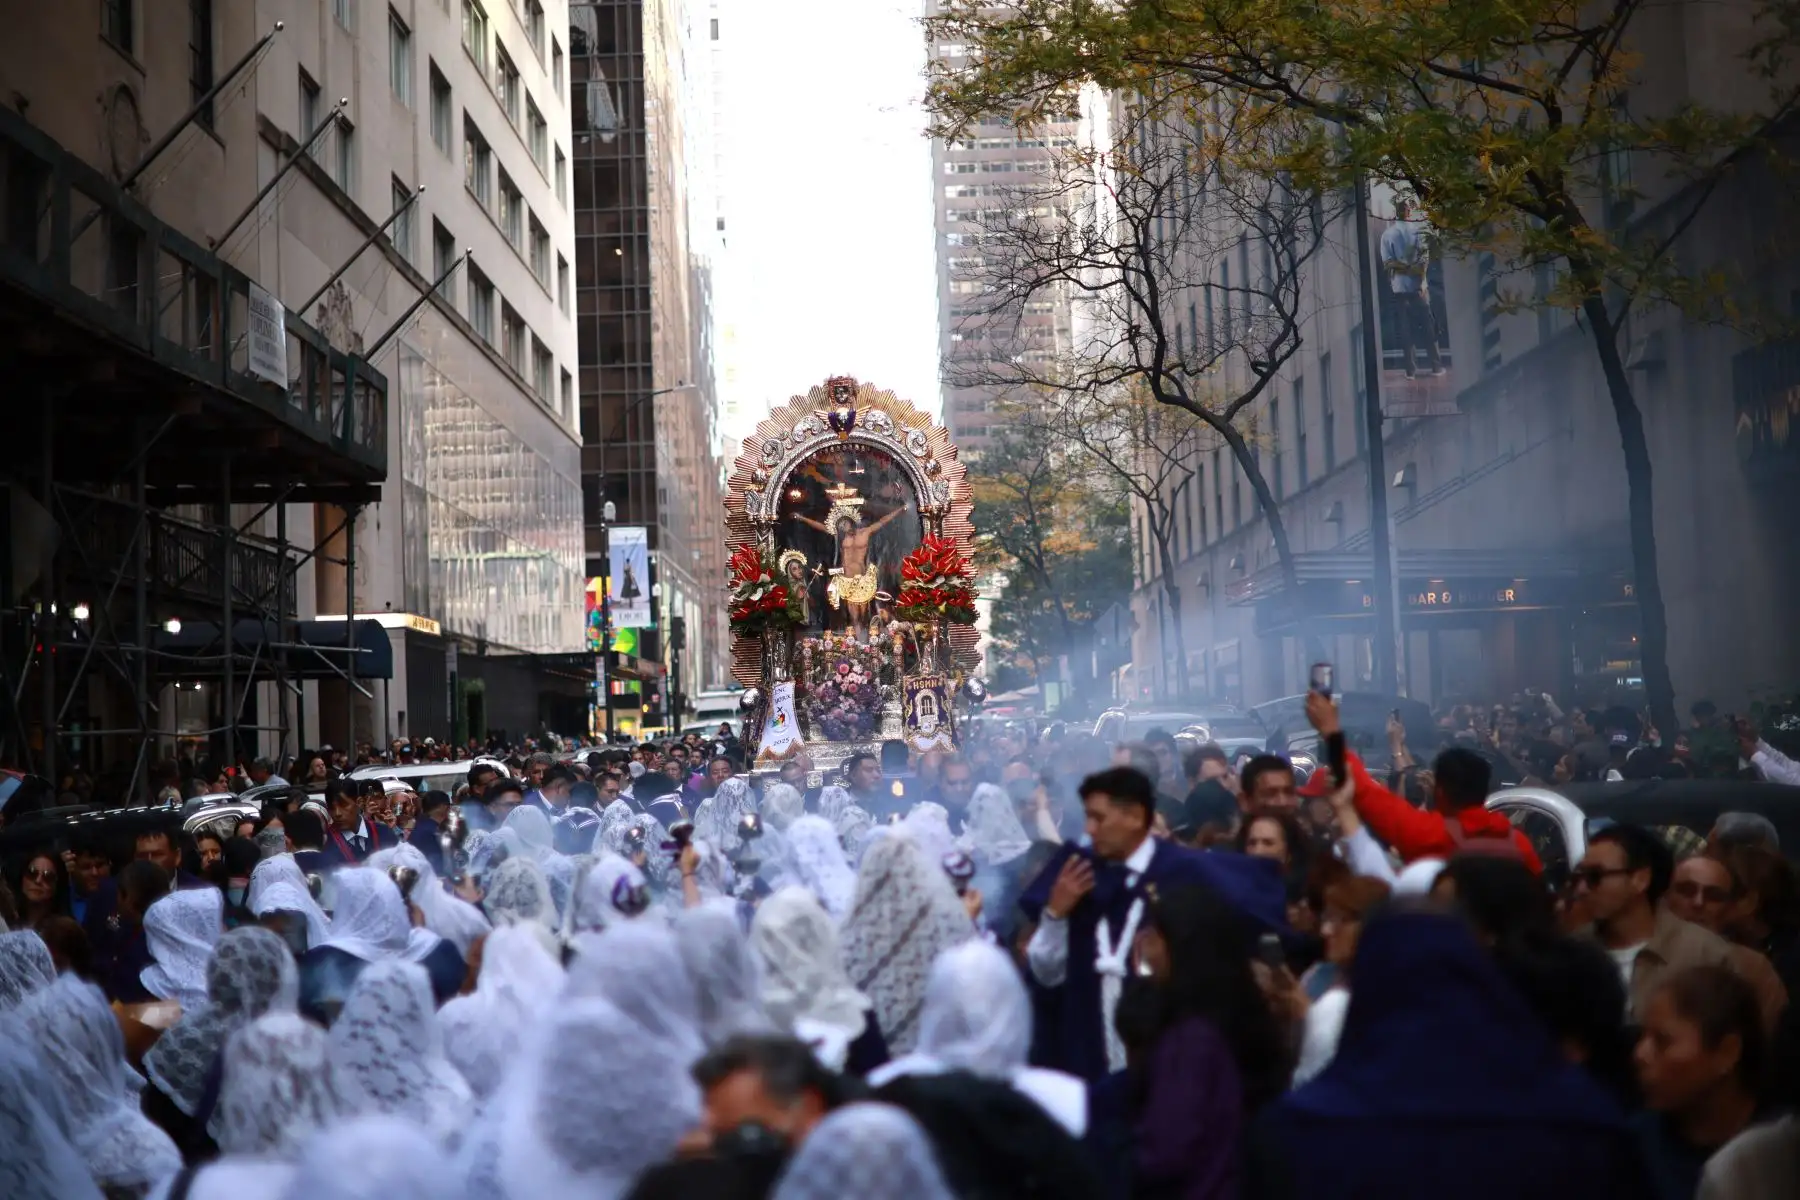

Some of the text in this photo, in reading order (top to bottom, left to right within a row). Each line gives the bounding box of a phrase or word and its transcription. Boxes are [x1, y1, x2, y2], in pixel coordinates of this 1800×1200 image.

[1408, 592, 1437, 606] BAR
[1441, 591, 1452, 604] &
[912, 679, 938, 690] HSMN
[773, 736, 790, 746] 2025
